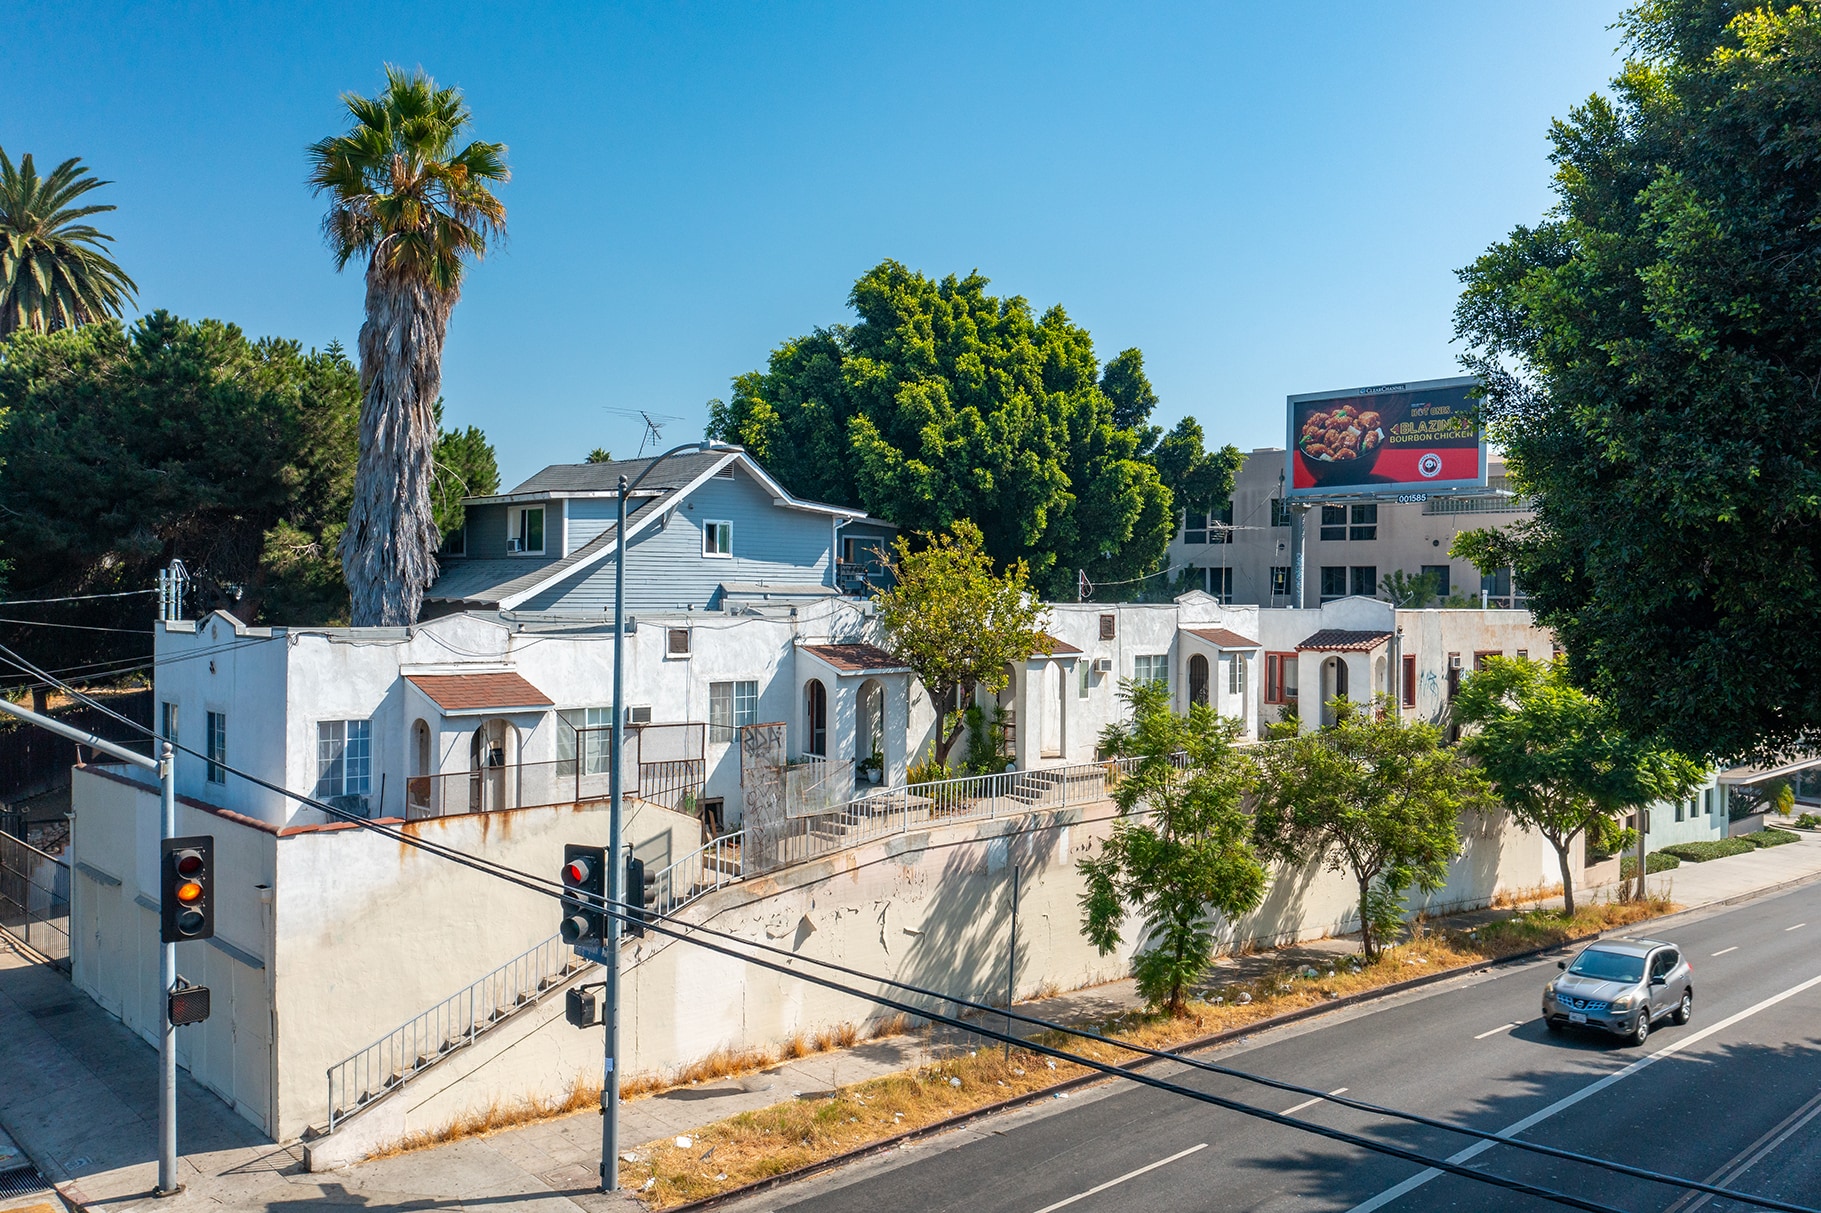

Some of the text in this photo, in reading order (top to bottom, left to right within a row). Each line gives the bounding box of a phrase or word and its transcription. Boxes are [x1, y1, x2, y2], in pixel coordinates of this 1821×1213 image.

[1400, 418, 1462, 434] BLAZIN
[1389, 430, 1473, 443] BOURBON CHICKEN
[1398, 494, 1427, 503] 001585
